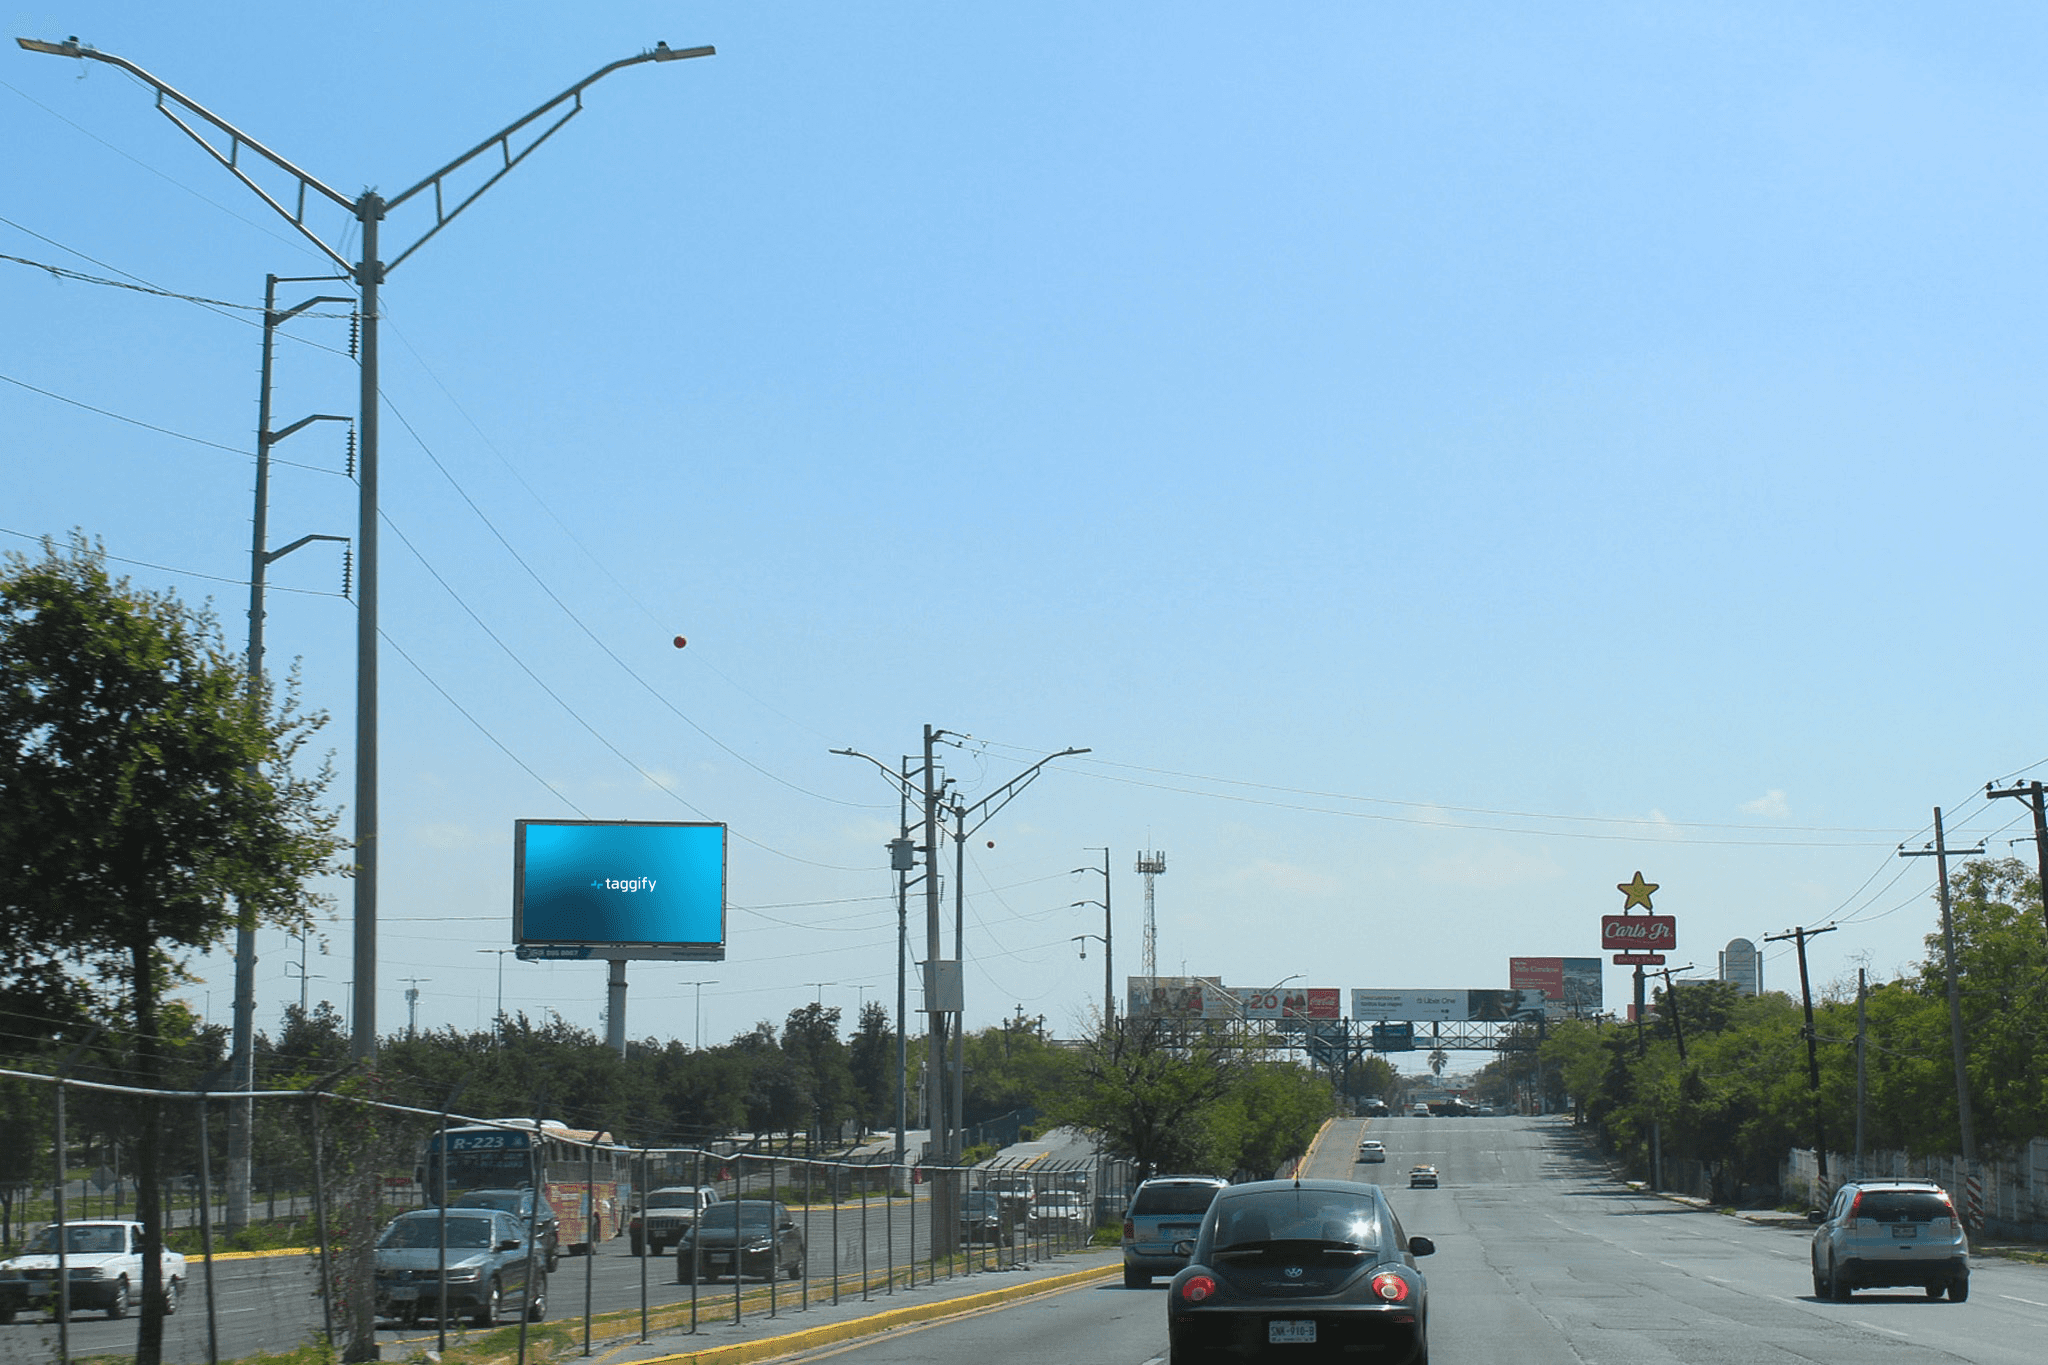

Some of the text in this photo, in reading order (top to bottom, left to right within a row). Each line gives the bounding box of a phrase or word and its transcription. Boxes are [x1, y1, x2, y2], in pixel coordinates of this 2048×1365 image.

[605, 877, 656, 892] taggify
[1605, 922, 1646, 938] Carl's
[1250, 994, 1278, 1010] 20
[1424, 997, 1456, 1005] Uber One
[453, 1136, 505, 1149] R-223
